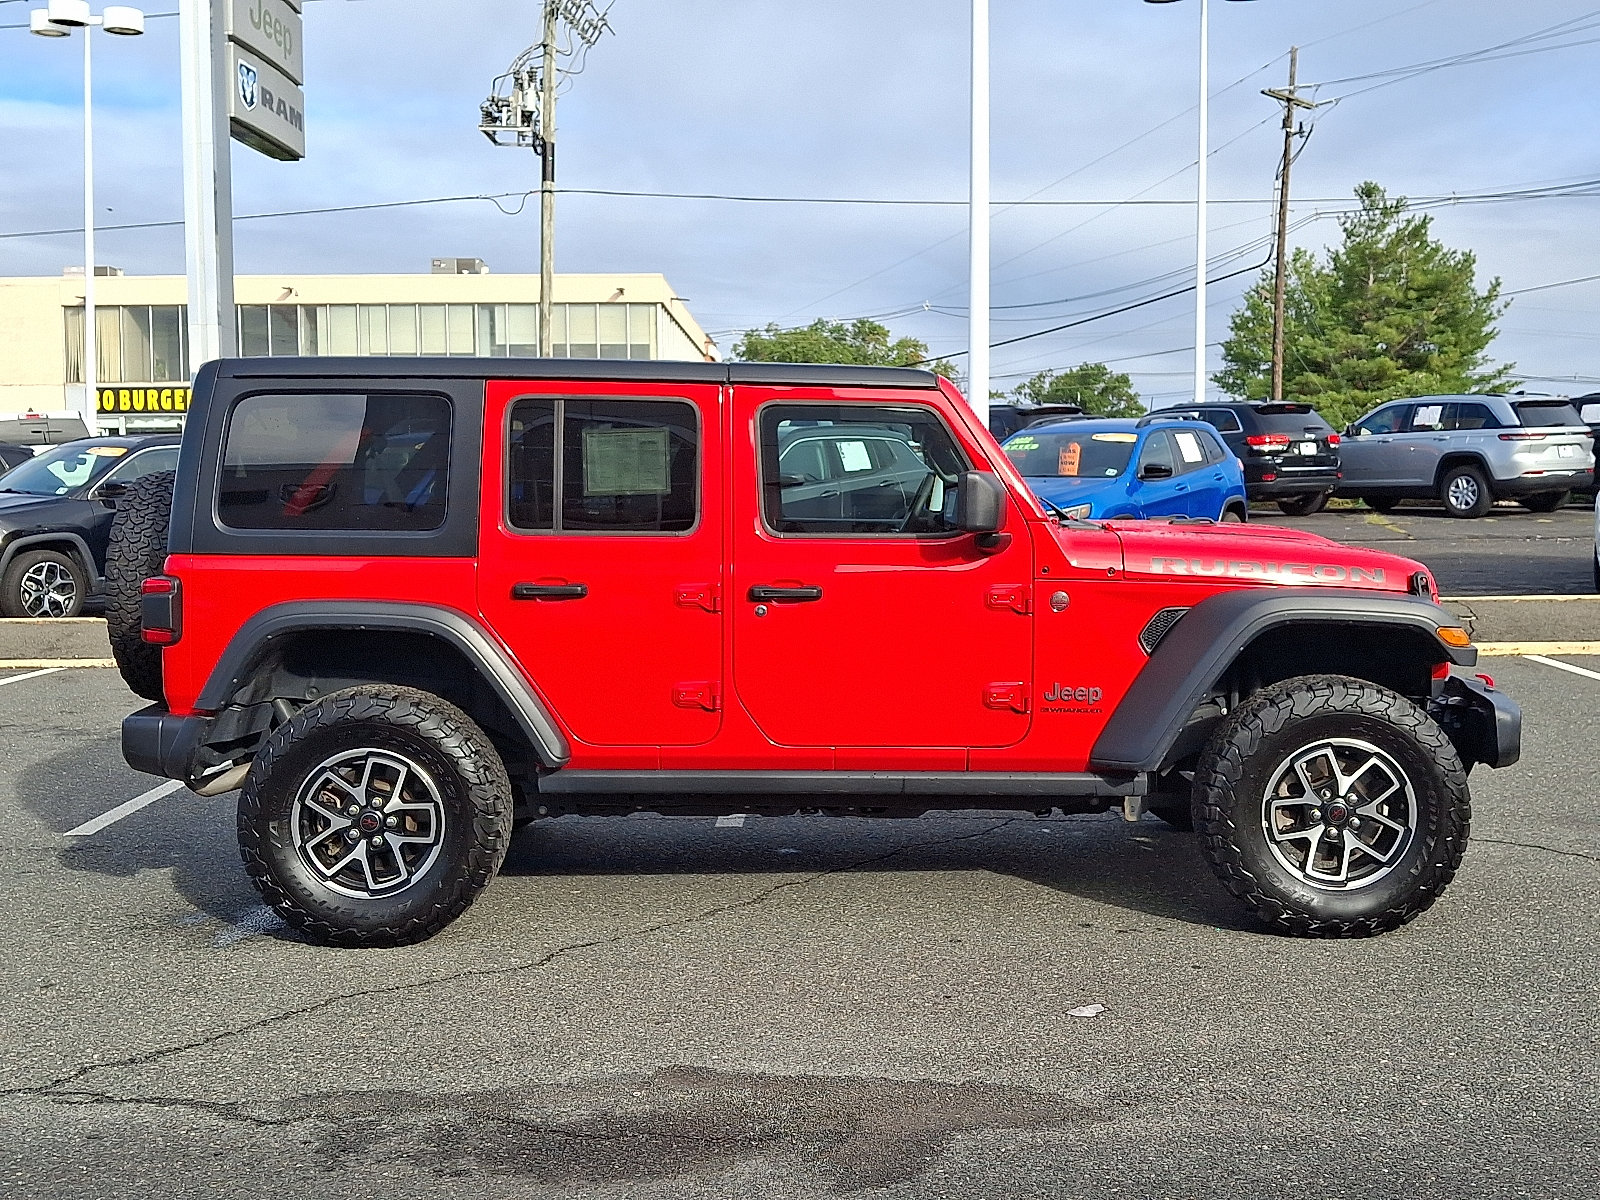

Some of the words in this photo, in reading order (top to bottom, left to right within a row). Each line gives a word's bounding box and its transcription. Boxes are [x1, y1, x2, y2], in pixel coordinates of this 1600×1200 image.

[250, 0, 292, 59] Jeep
[261, 86, 303, 132] RAM
[1150, 557, 1387, 583] RUBICON
[1044, 682, 1103, 705] Jeep
